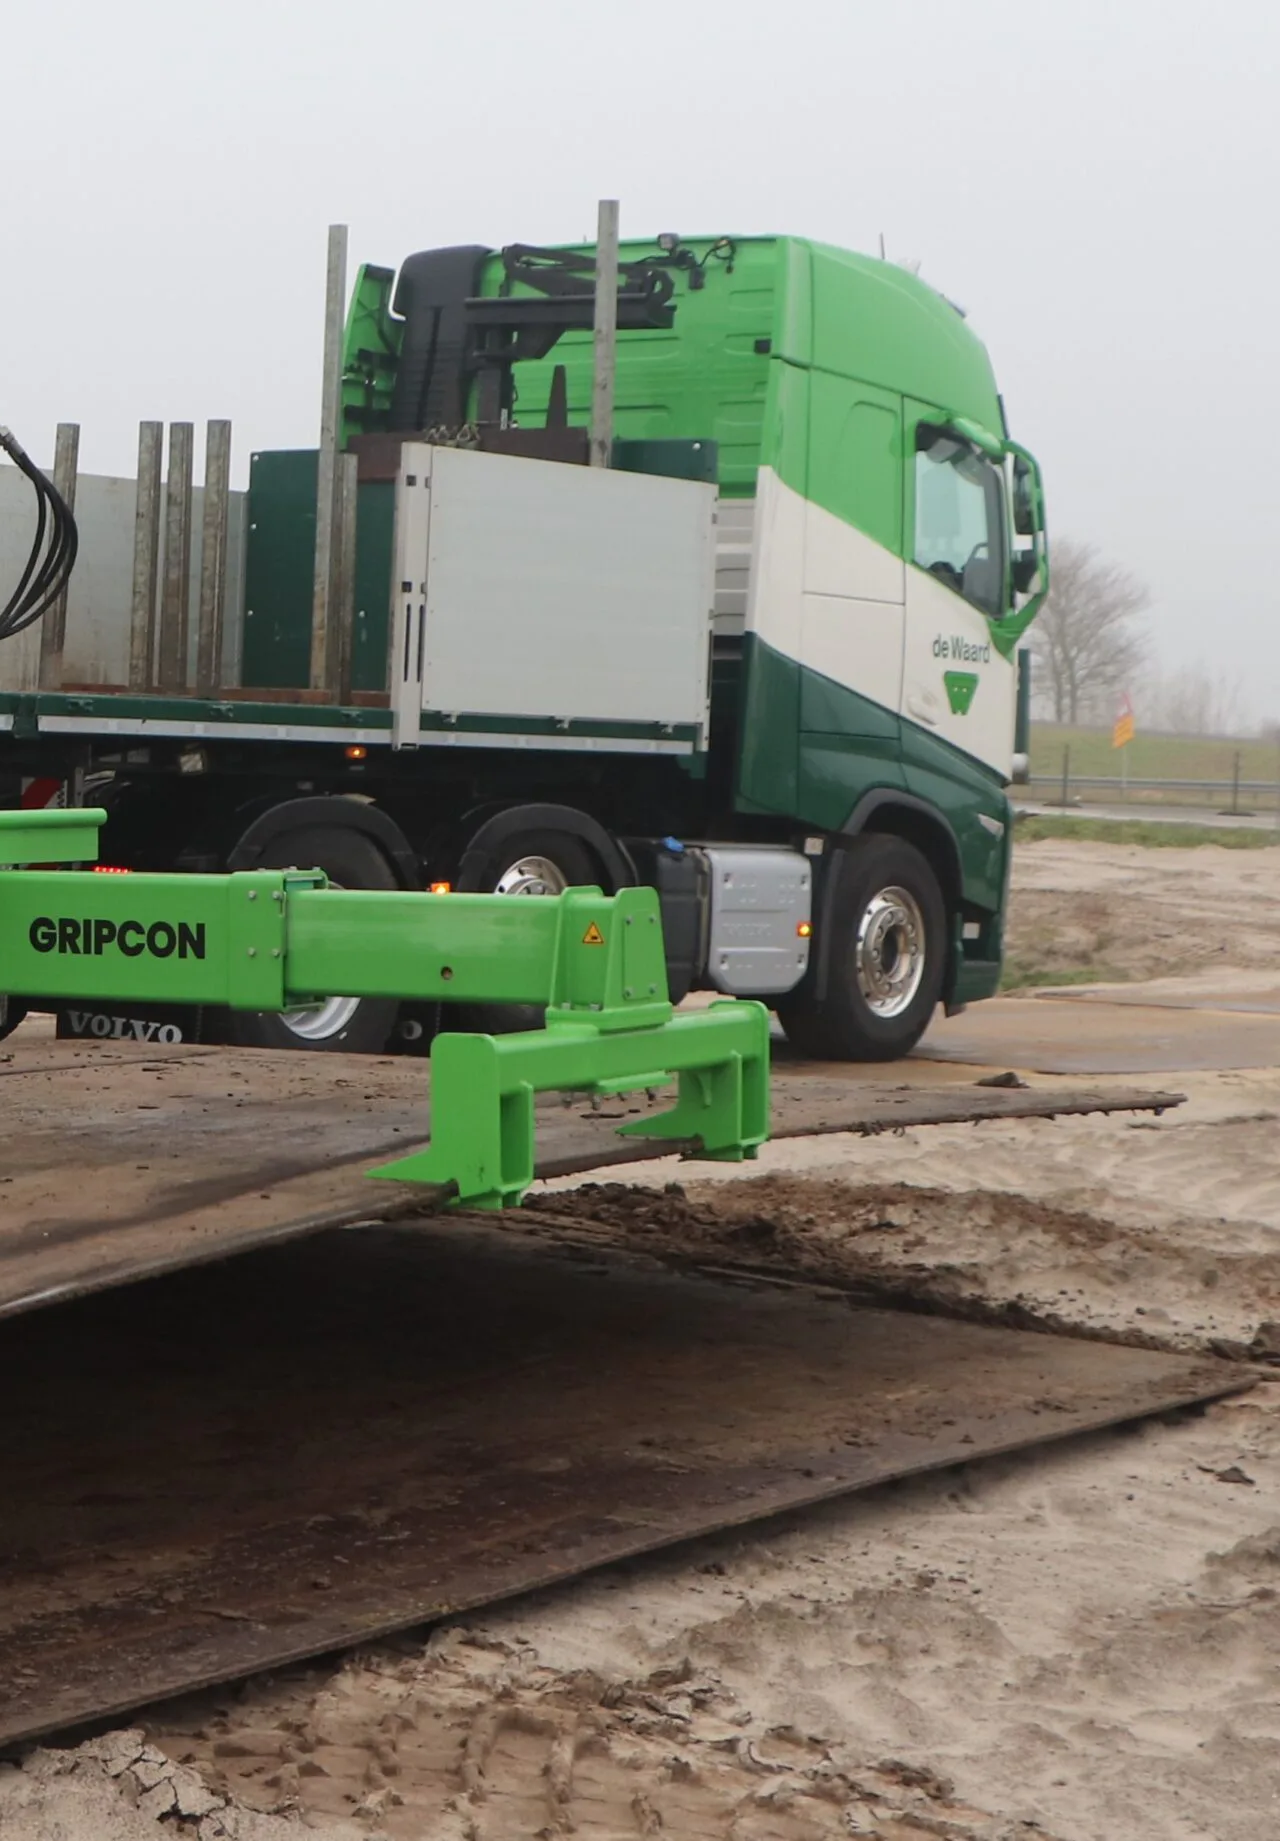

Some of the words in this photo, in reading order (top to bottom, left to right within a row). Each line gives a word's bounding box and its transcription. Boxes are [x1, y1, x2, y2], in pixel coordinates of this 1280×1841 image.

[932, 633, 949, 659] de
[951, 635, 990, 664] Waard
[29, 916, 206, 960] GRIPCON
[67, 1009, 183, 1044] VOLVO
